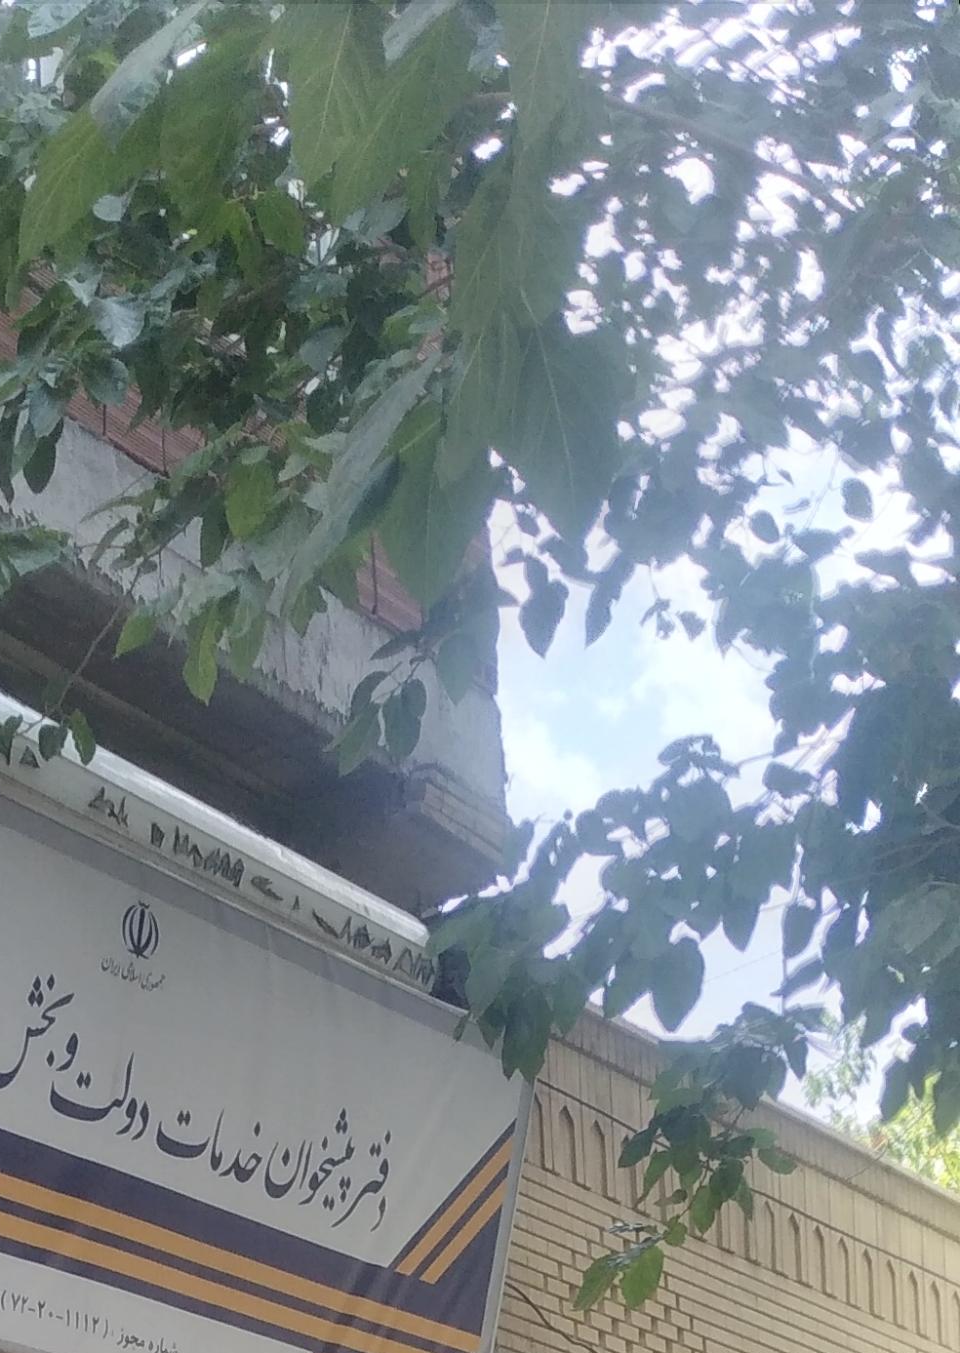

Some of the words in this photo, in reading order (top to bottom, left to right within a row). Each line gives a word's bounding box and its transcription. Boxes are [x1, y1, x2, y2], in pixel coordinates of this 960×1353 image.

[49, 1051, 149, 1141] دولت
[156, 1107, 263, 1184] خدمات
[264, 1107, 355, 1211] پیشخوان
[331, 1129, 392, 1232] دفتر
[116, 1328, 145, 1347] مجوز
